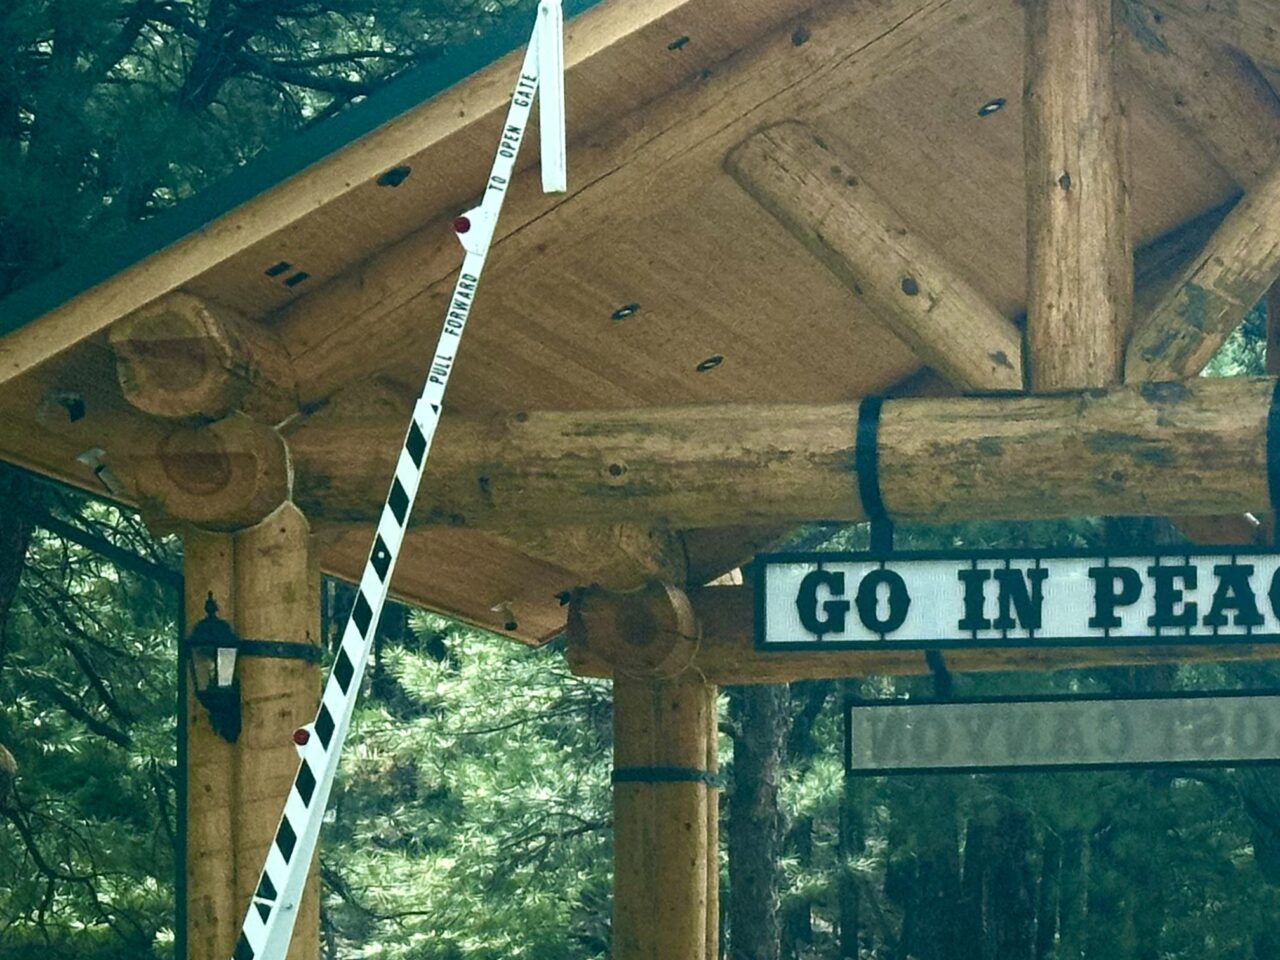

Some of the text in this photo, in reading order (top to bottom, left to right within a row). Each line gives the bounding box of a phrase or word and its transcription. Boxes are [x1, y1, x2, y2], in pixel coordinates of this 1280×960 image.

[430, 73, 538, 385] PULL FORWARD TO OPEN GATE
[796, 569, 911, 635] GO
[957, 567, 1049, 631] IN
